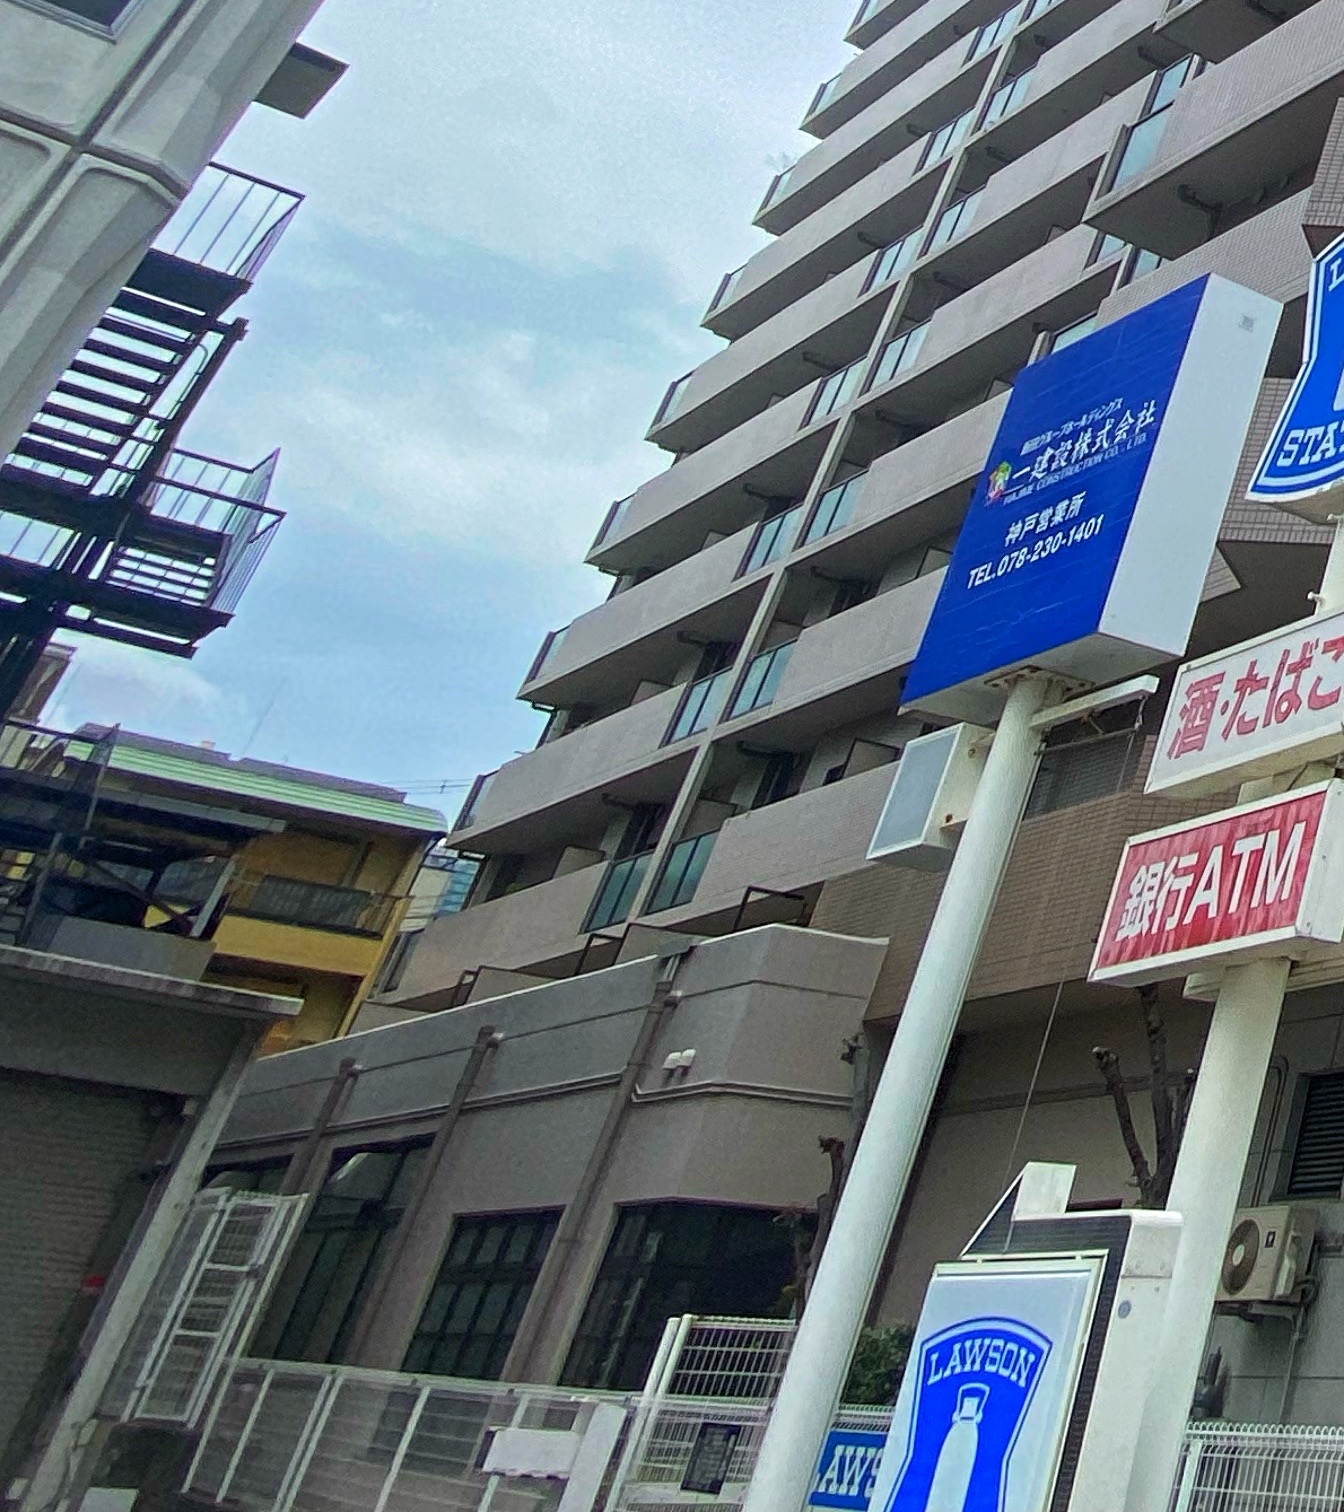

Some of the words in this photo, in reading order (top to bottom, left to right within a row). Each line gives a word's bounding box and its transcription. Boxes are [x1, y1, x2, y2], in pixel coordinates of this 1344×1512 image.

[968, 514, 1104, 588] TEL.078-230-1401
[1004, 491, 1087, 547] 神戸営業所
[1117, 823, 1303, 941] 銀行ATM
[927, 1337, 1035, 1387] LAWSON
